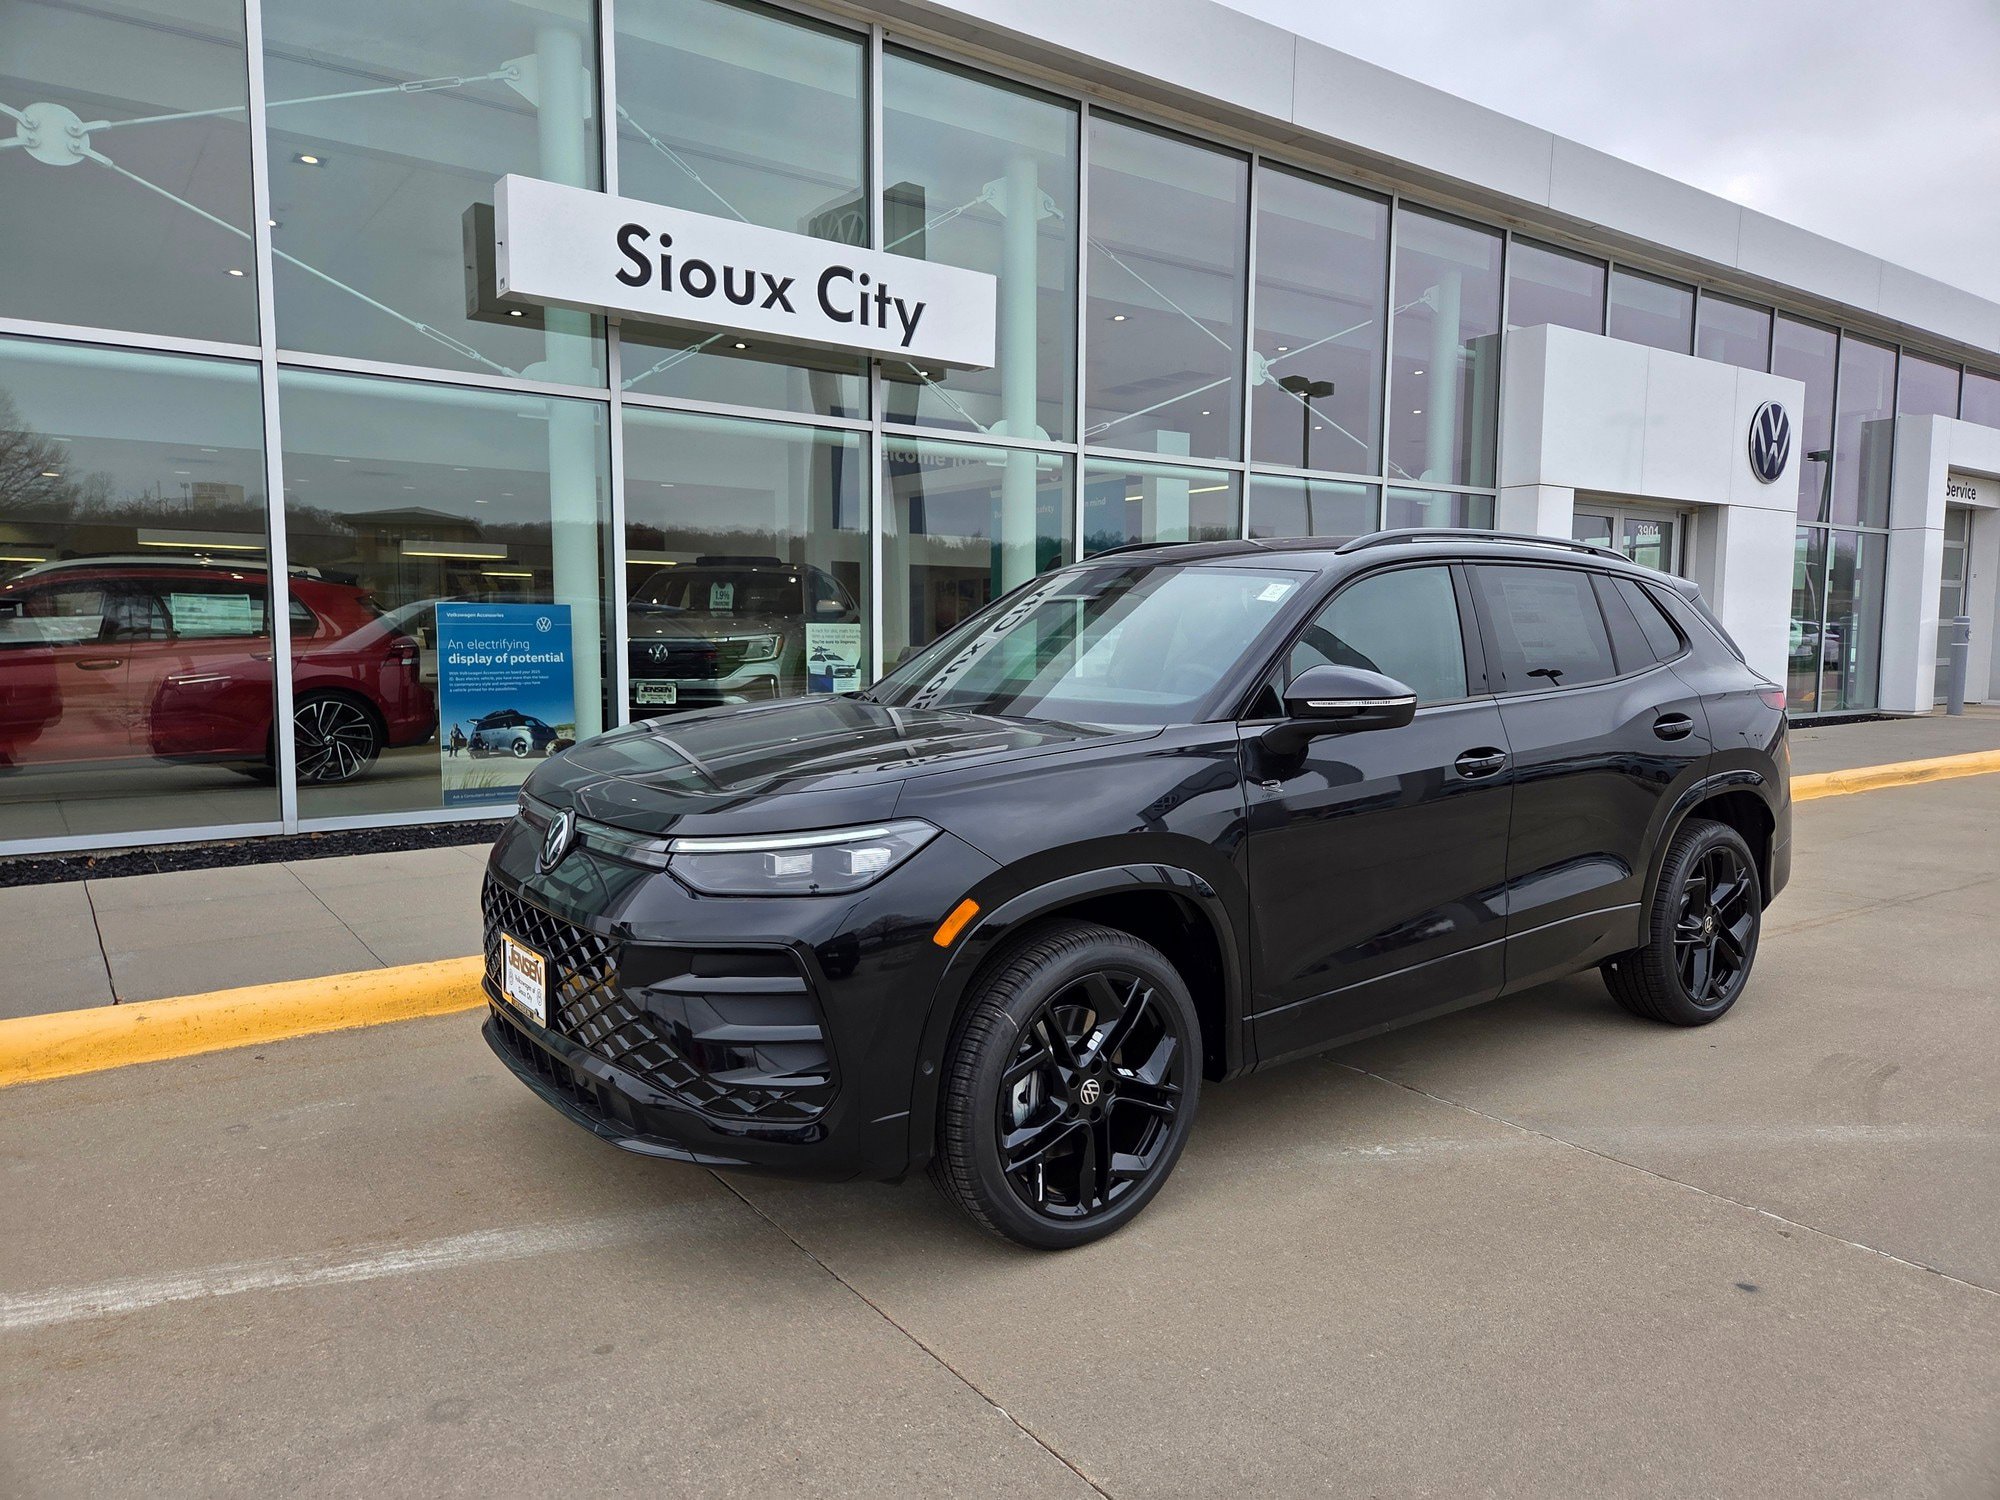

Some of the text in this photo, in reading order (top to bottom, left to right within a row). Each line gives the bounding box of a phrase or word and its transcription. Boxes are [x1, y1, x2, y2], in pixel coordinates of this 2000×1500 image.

[615, 222, 927, 348] Sioux City
[1946, 476, 1976, 500] Service
[1637, 524, 1660, 537] 3901
[448, 639, 530, 652] An electrifying
[448, 652, 564, 666] display of potential
[509, 948, 542, 986] JENSEN
